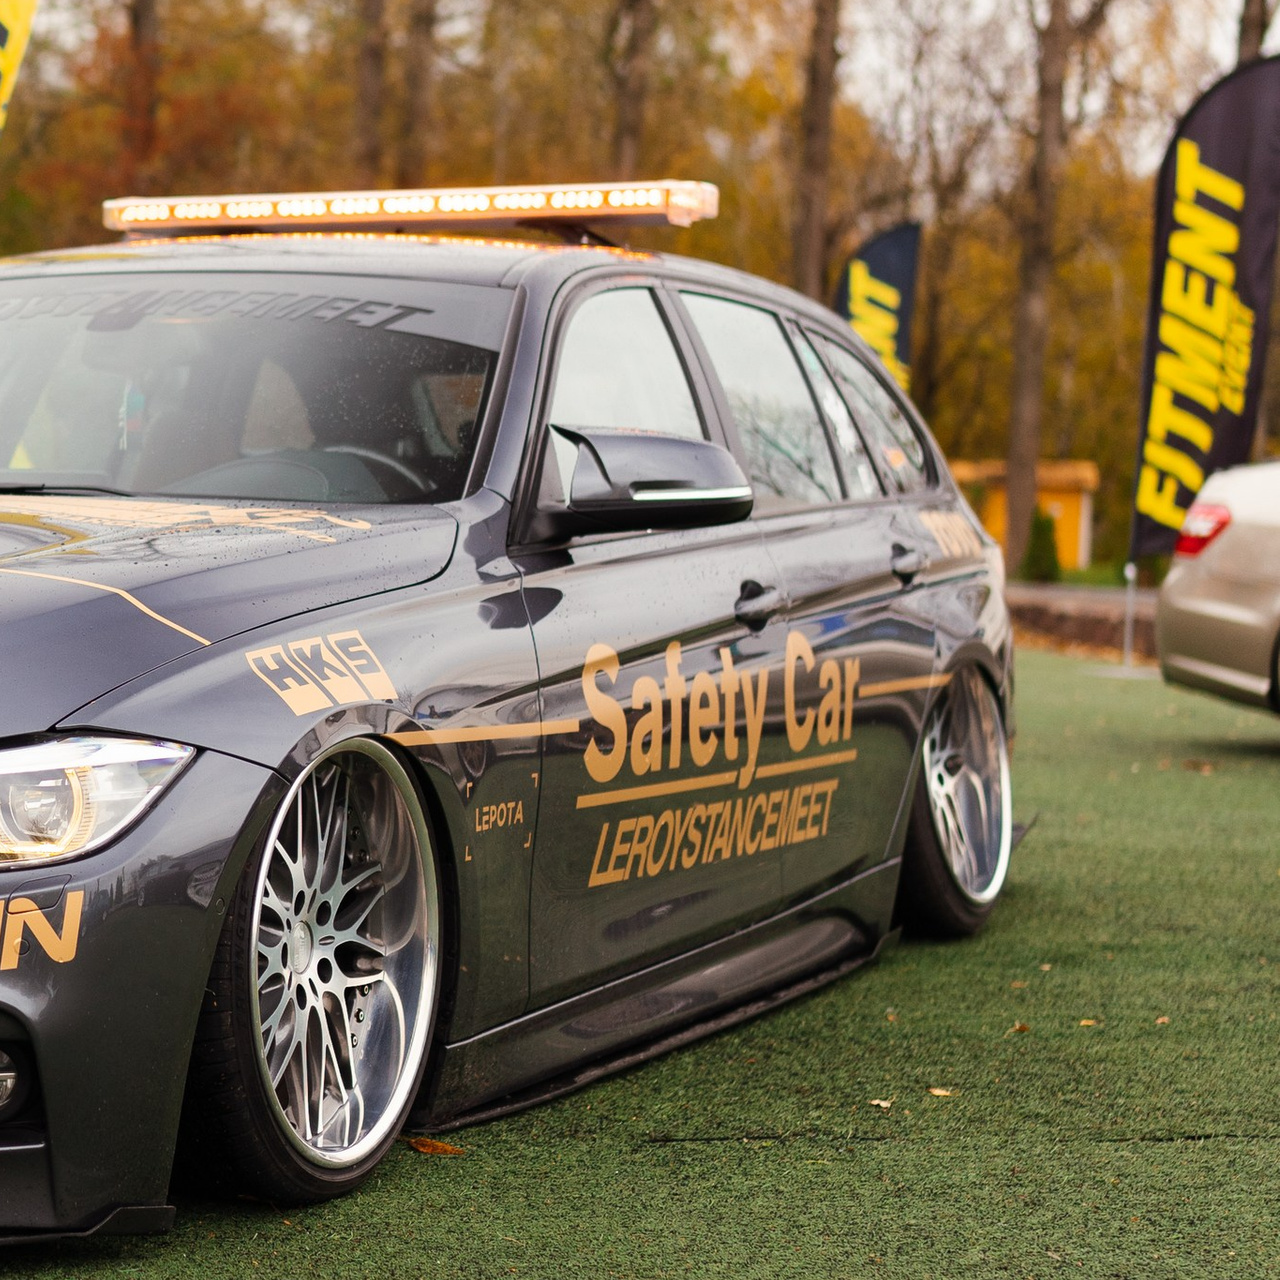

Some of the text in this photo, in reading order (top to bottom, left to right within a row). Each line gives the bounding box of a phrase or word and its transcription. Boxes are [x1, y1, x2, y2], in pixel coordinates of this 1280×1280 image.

[1135, 136, 1246, 532] FITMENT
[250, 634, 385, 697] HKS
[581, 630, 861, 790] Safety Car
[475, 800, 524, 832] LEPOTA
[587, 778, 839, 888] LEROYSTANCEMEET
